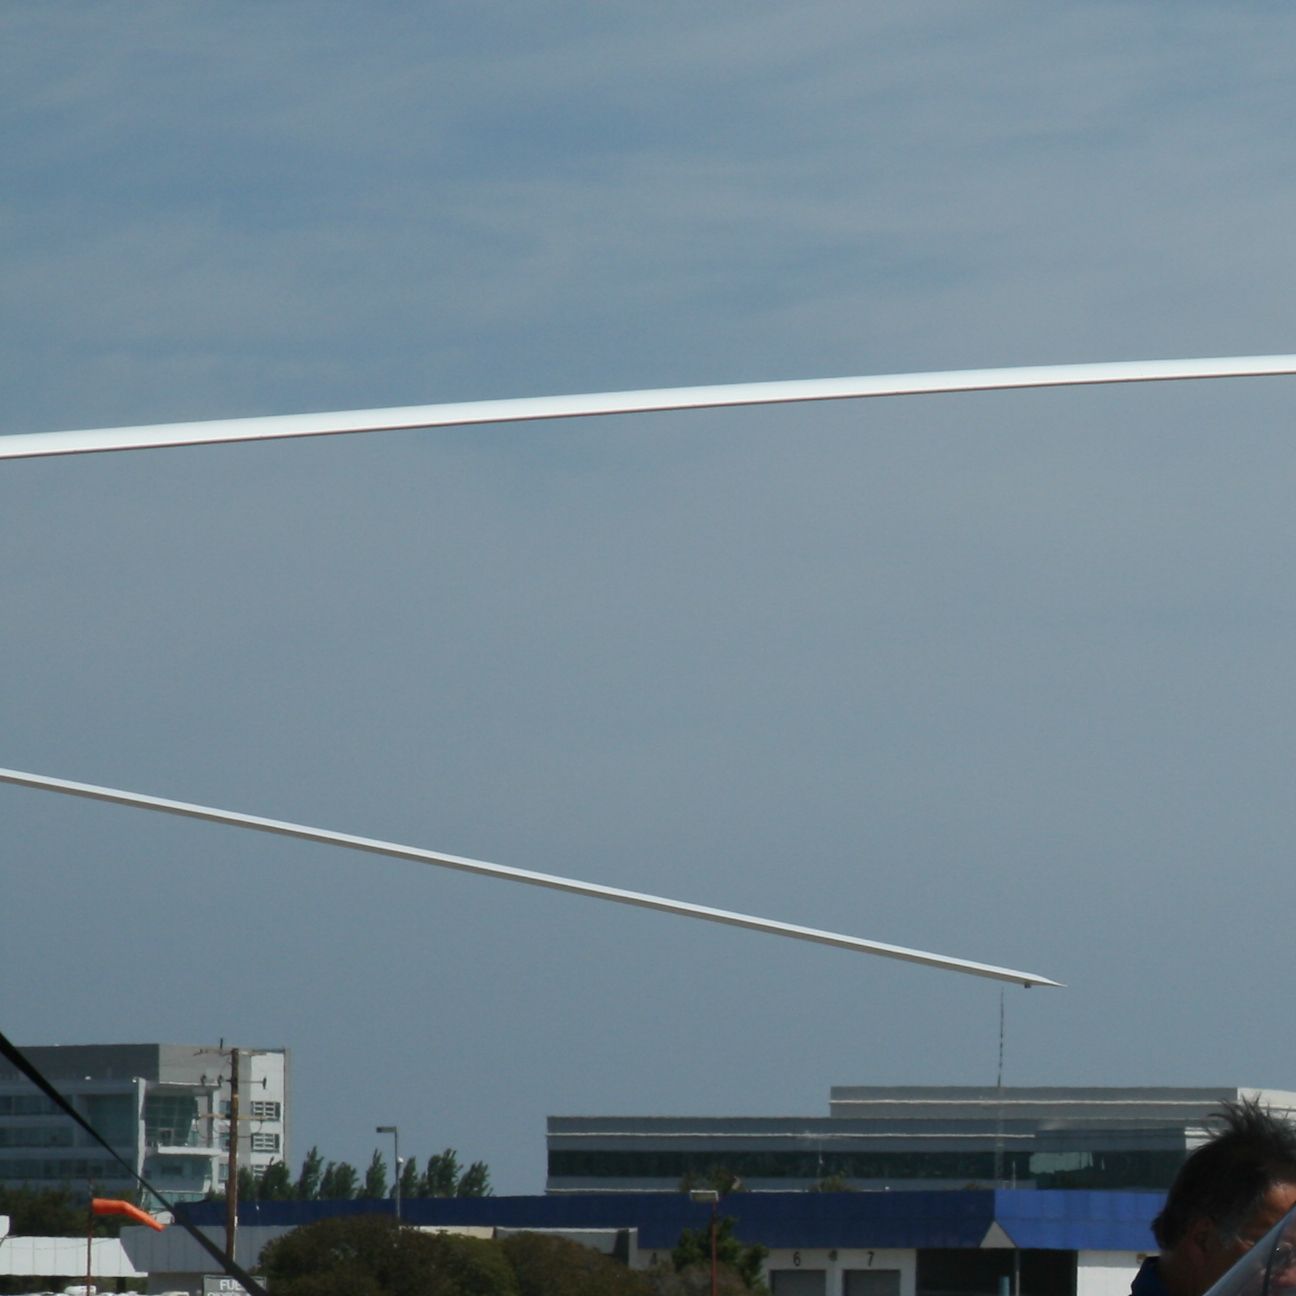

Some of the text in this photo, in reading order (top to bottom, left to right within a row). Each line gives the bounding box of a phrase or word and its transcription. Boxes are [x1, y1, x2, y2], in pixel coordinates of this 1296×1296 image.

[793, 1251, 801, 1267] 6
[867, 1251, 875, 1267] 7
[220, 1279, 247, 1291] FUE
